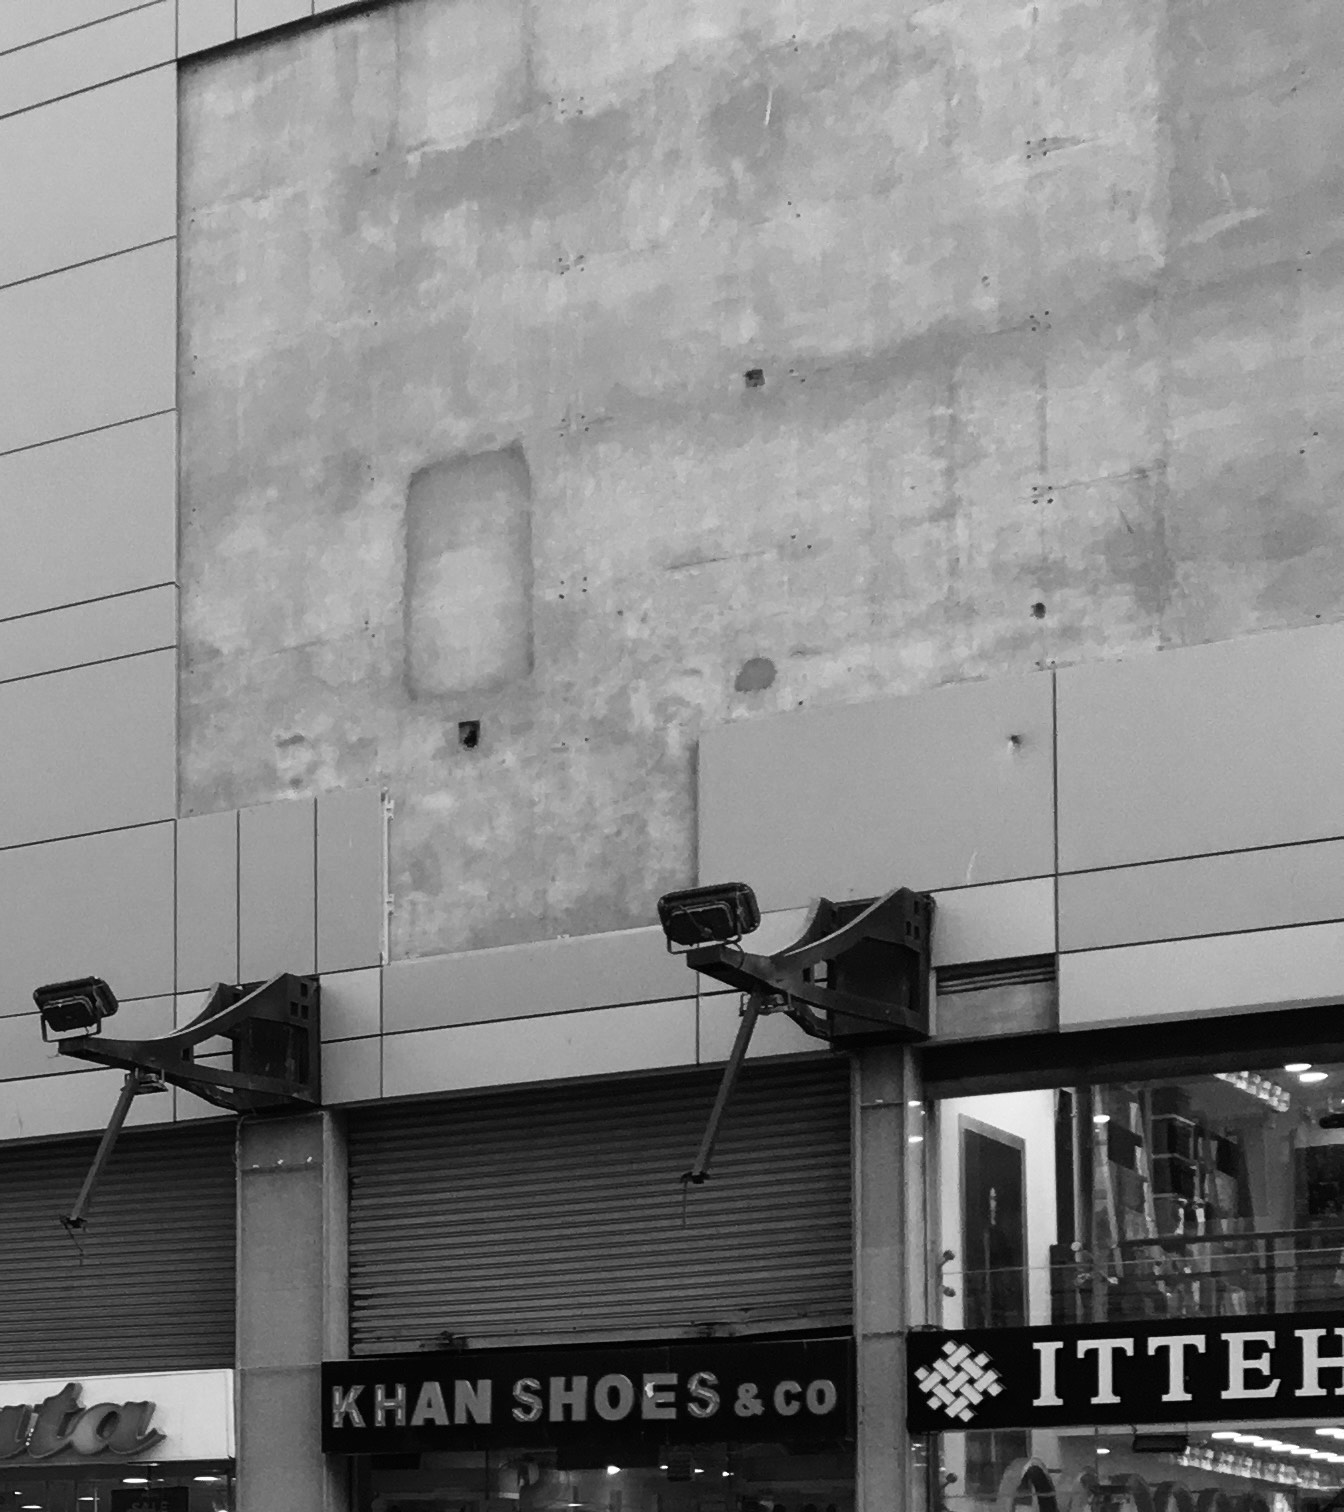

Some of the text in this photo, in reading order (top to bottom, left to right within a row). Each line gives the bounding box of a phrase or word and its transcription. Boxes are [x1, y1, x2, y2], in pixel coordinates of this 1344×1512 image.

[332, 1380, 492, 1428] KHAN
[512, 1371, 720, 1423] SHOES
[1032, 1327, 1344, 1407] ITTEH
